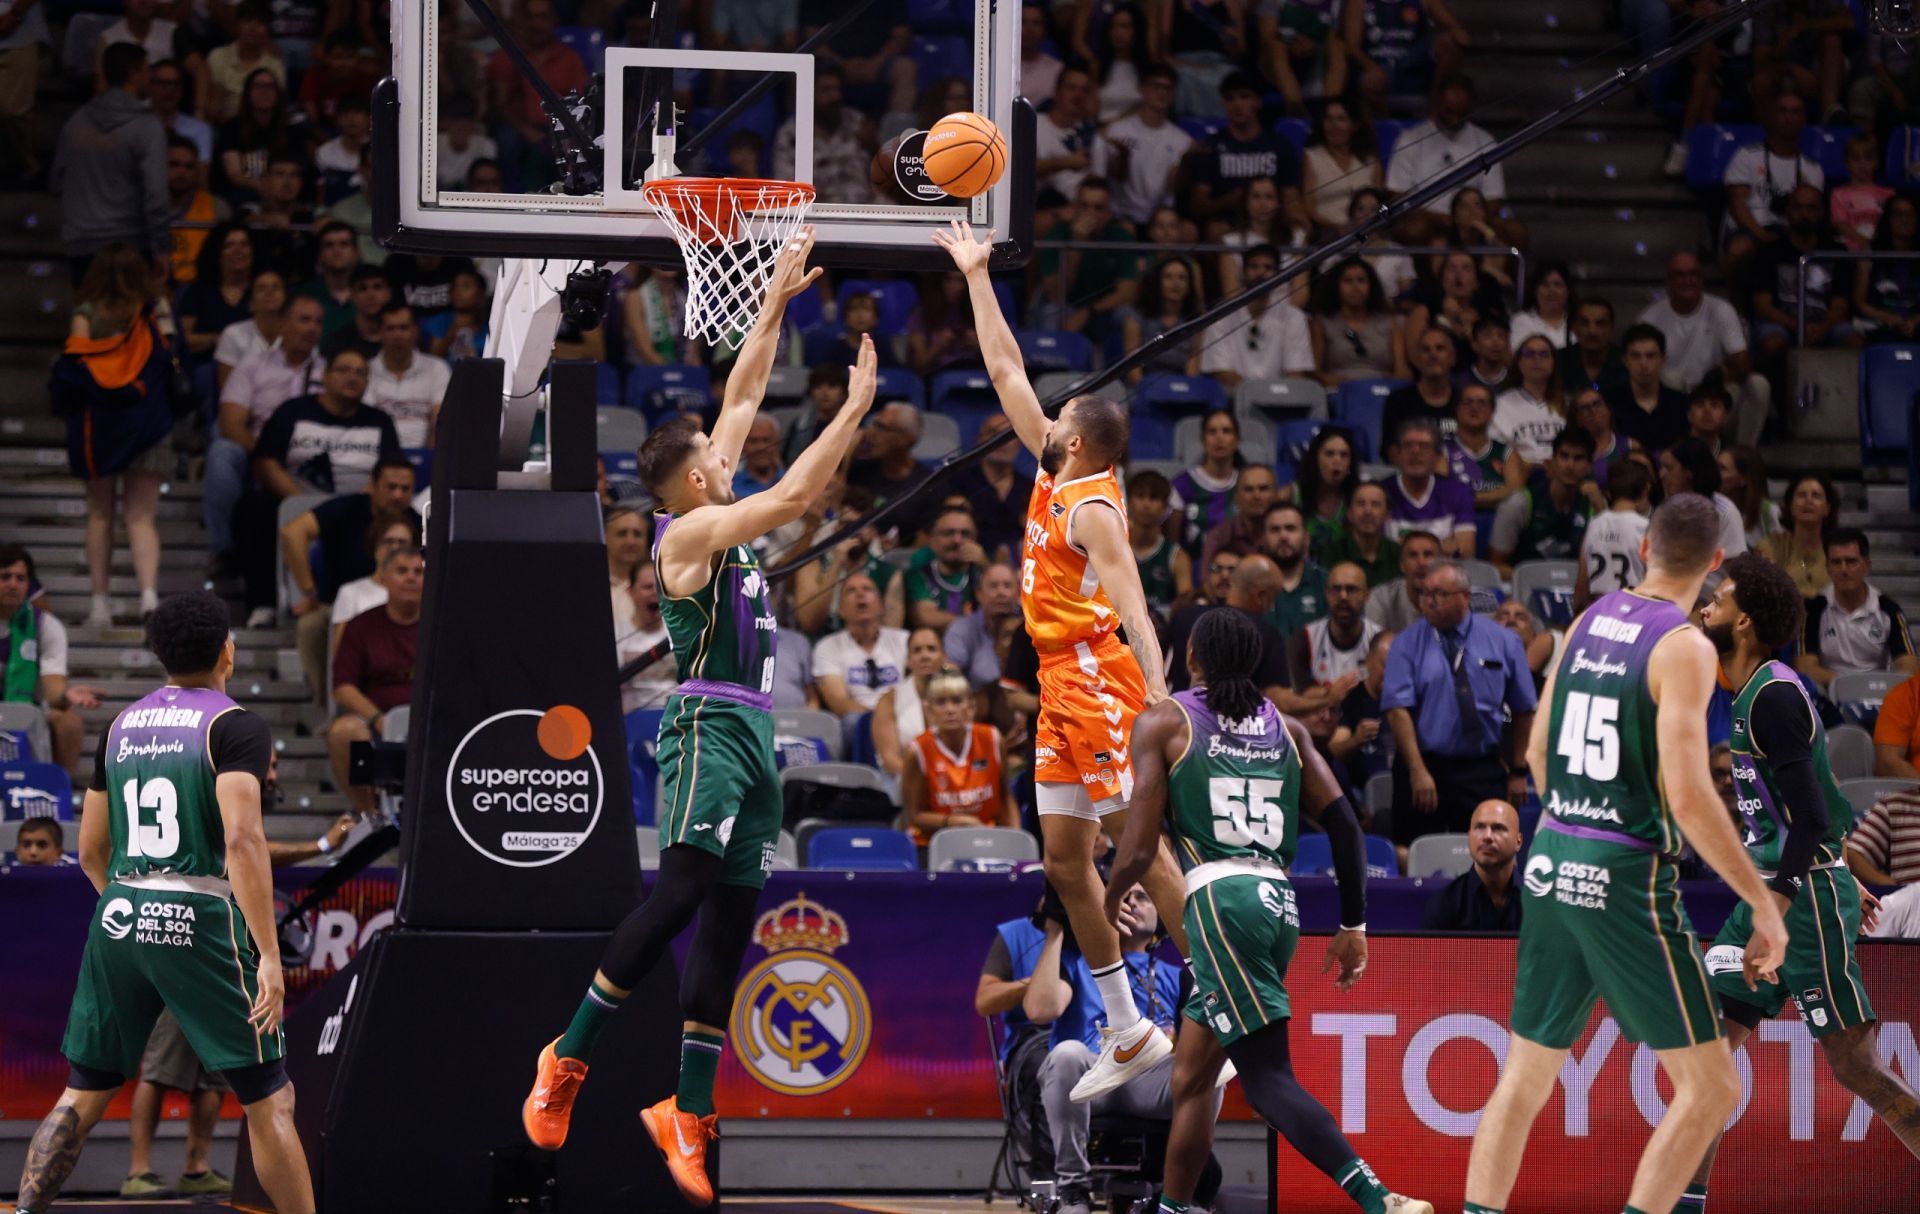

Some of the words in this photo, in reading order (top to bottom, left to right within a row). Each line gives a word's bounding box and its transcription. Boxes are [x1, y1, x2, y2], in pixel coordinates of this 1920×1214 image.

[1590, 552, 1630, 590] 23
[121, 705, 203, 730] CASTAÑEDA
[1557, 690, 1619, 782] 45
[461, 767, 589, 789] supercopa
[472, 786, 589, 813] endesa
[123, 777, 180, 859] 13
[1209, 777, 1285, 851] 55
[507, 834, 578, 849] Málaga'25
[1558, 861, 1610, 884] COSTA
[1556, 877, 1576, 892] DEL
[1577, 881, 1608, 897] SOL
[1555, 890, 1606, 910] MÁLAGA
[140, 902, 196, 921] COSTA
[136, 918, 162, 932] DEL
[164, 921, 194, 935] SOL
[135, 930, 193, 947] MÁLAGA
